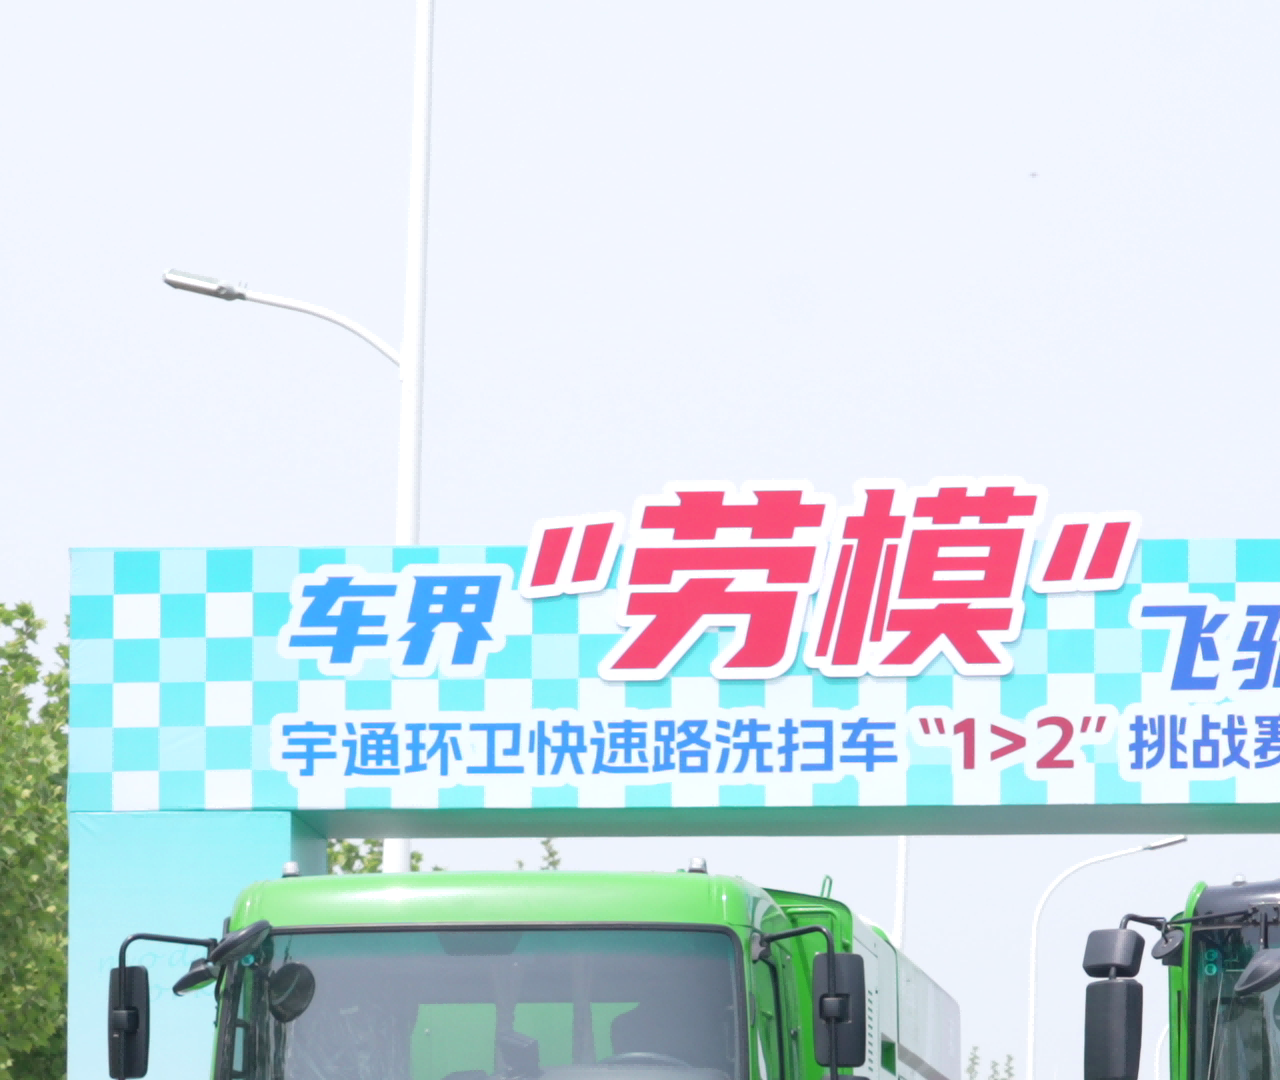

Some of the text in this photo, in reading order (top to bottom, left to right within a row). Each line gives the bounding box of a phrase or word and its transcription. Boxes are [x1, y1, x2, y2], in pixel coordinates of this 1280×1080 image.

[288, 575, 503, 667] 车界
[280, 716, 899, 777] 宇通环卫快速路洗扫车
